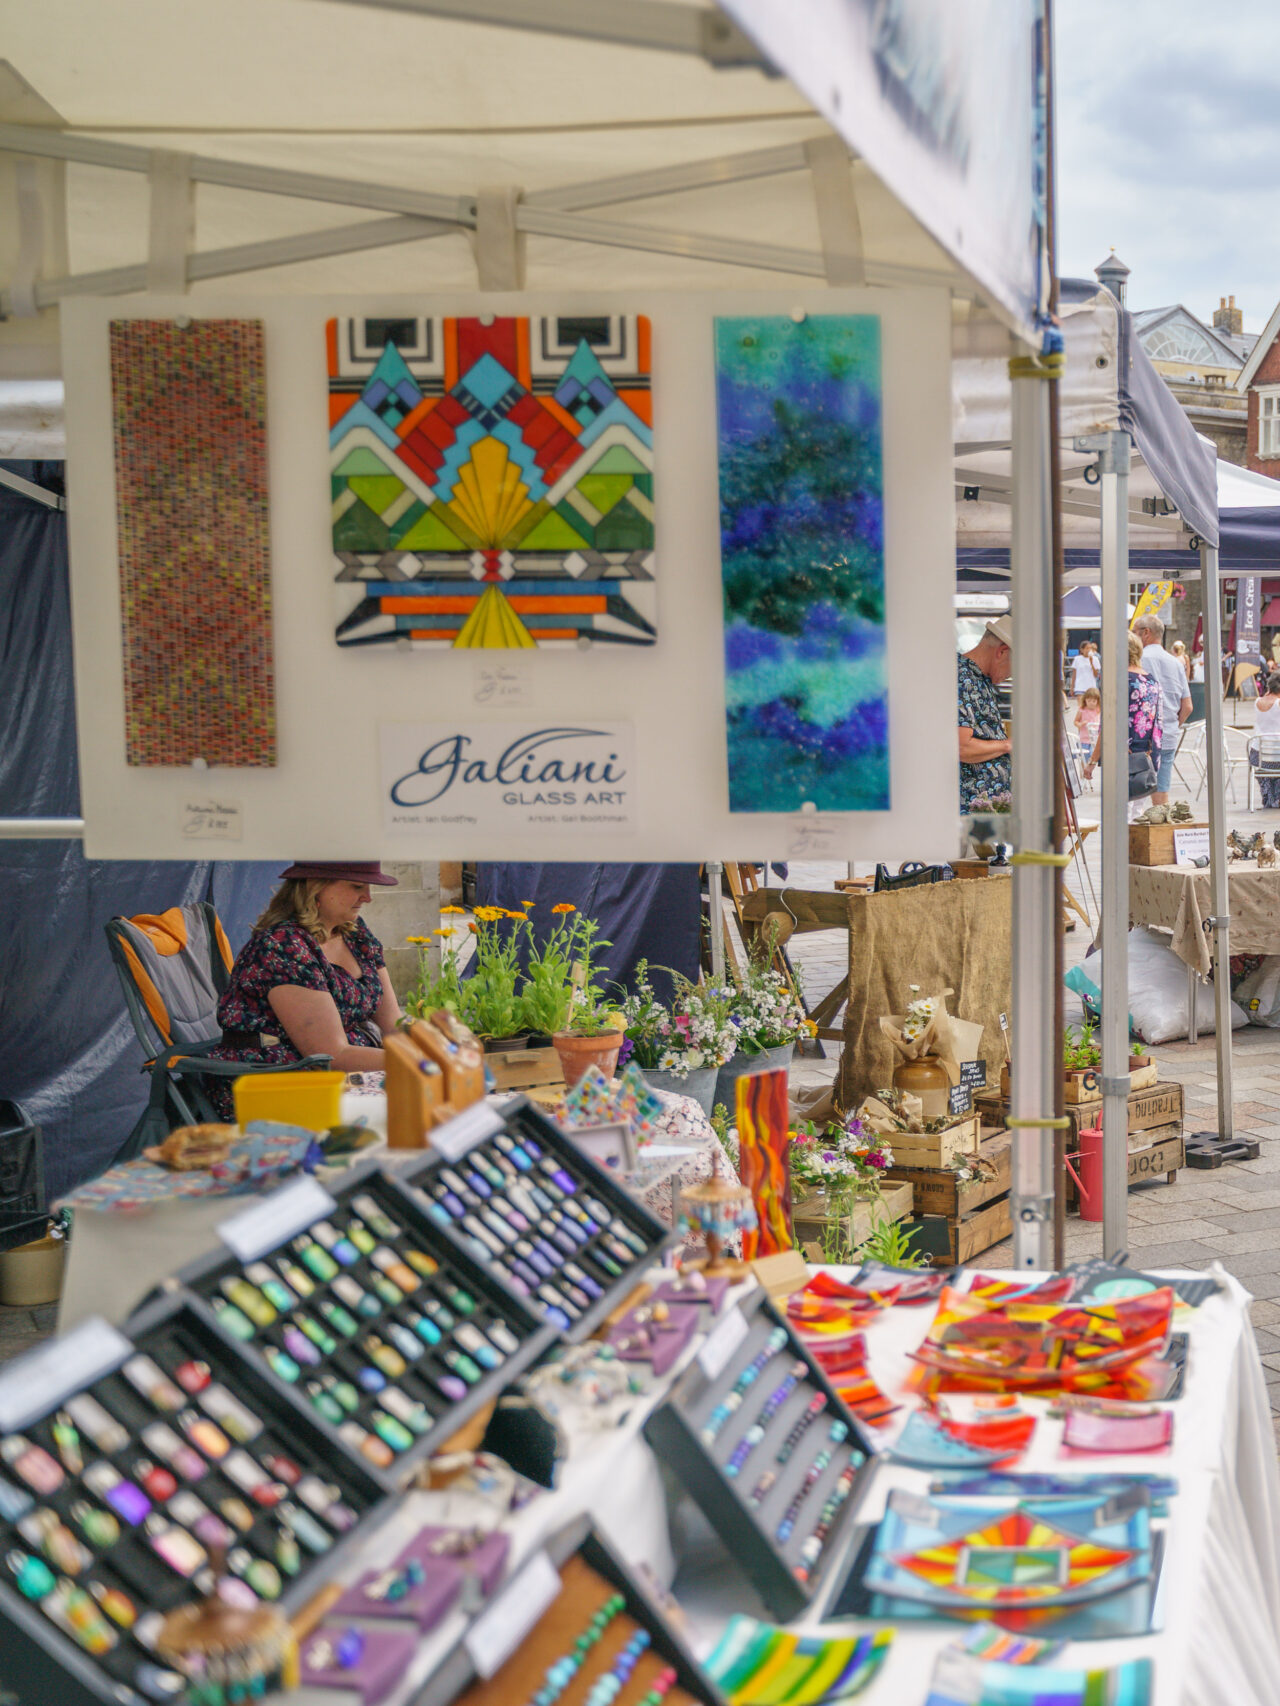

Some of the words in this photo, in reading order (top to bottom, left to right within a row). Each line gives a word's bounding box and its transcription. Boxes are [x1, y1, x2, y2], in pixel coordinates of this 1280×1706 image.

[1246, 576, 1255, 607] Crea
[1245, 610, 1254, 629] Ice
[391, 727, 626, 807] Galiani
[503, 792, 577, 805] GLASS
[584, 792, 626, 805] ART
[392, 815, 422, 823] Artist:
[441, 815, 478, 825] Godfrey
[528, 815, 558, 823] Artist:
[580, 814, 628, 823] Boothman
[1128, 1151, 1164, 1176] Dor
